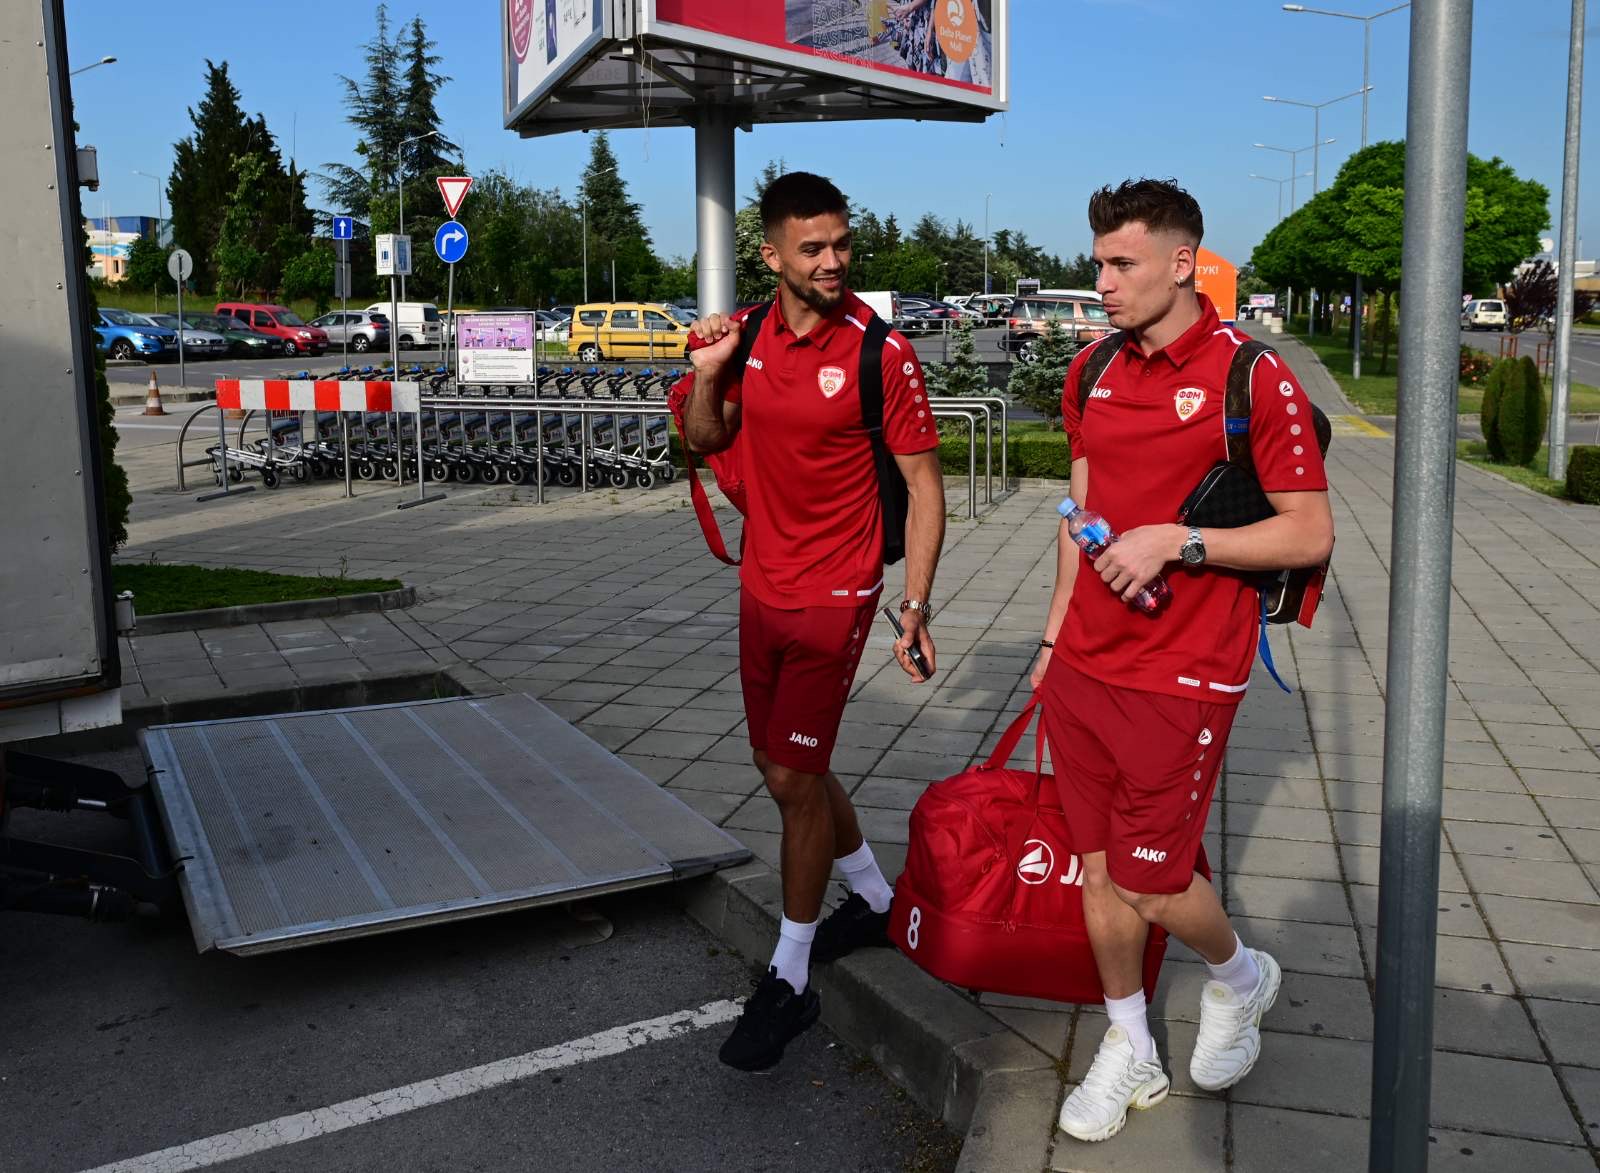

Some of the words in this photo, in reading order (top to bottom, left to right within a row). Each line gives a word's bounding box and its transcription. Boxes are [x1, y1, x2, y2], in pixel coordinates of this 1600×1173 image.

[940, 25, 955, 38] Delta
[745, 356, 763, 370] AKO
[1088, 388, 1112, 399] AKO
[1179, 390, 1202, 400] ФФМ
[788, 731, 818, 748] JAKO
[1131, 846, 1167, 863] JAKO
[907, 906, 921, 950] 8
